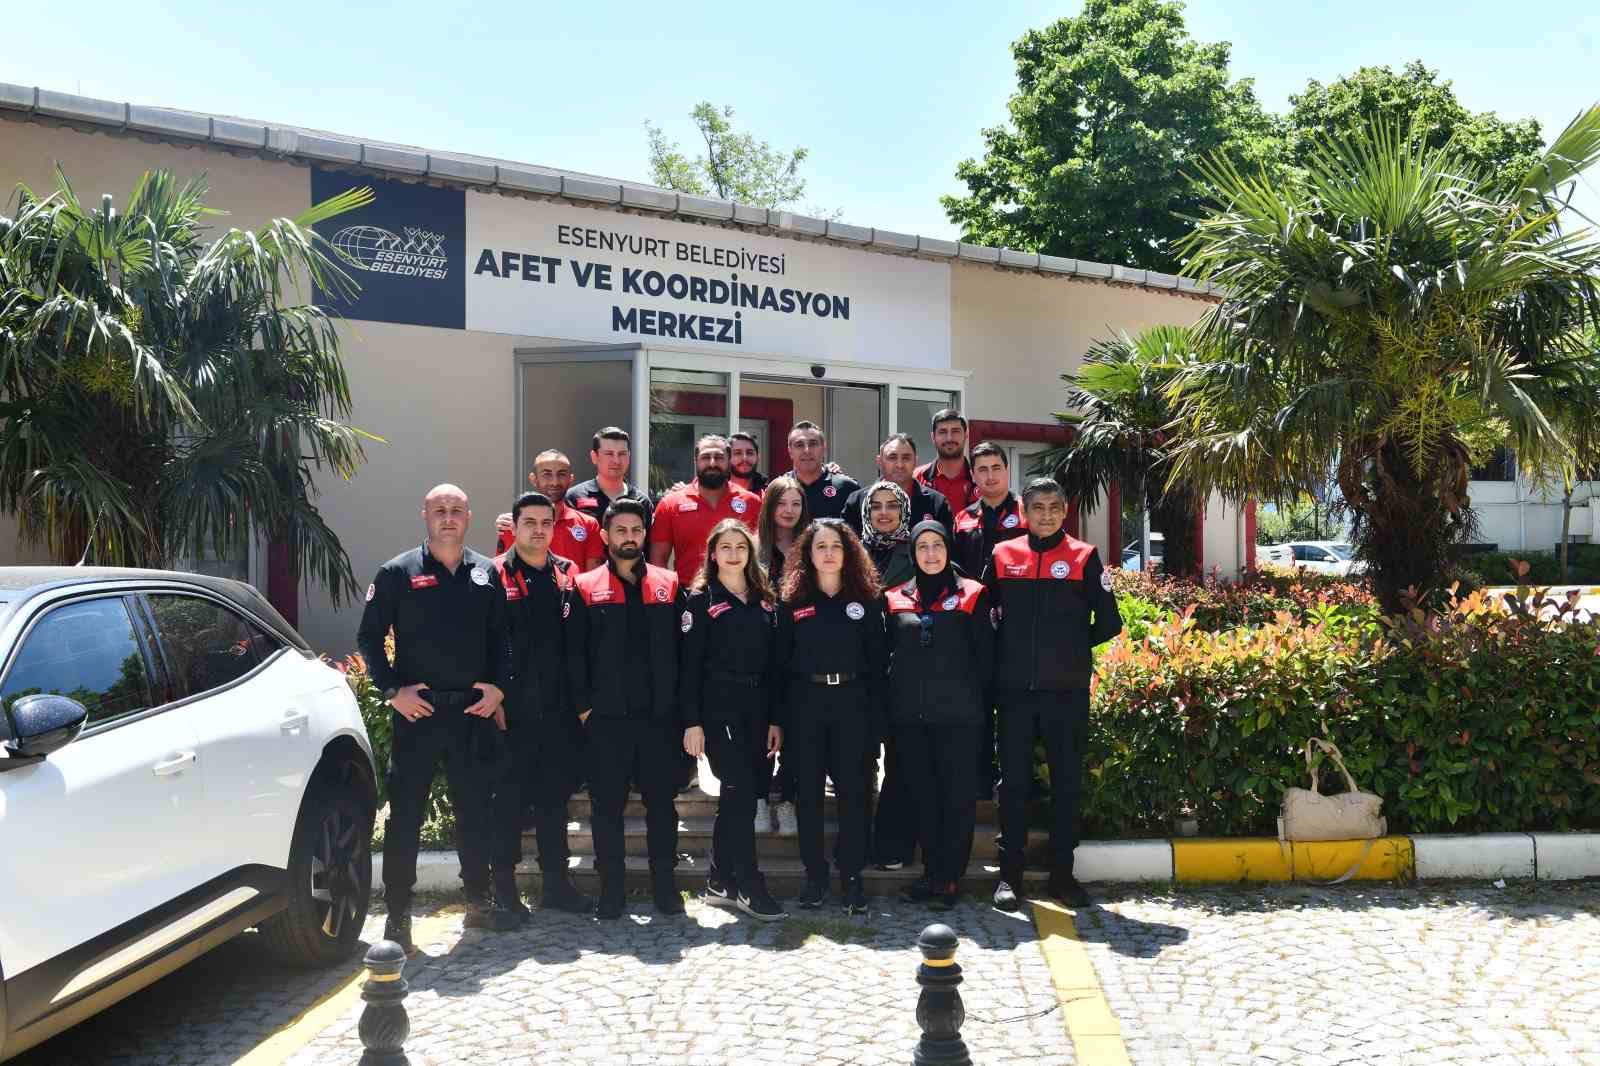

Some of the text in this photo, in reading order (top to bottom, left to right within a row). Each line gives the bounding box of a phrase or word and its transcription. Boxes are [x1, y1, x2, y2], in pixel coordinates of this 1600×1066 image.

[375, 251, 446, 269] ESENYURT
[558, 225, 785, 275] ESENYURT BELEDİYESİ
[473, 248, 850, 320] AFET VE KOORDİNASYON
[612, 305, 742, 344] MERKEZİ
